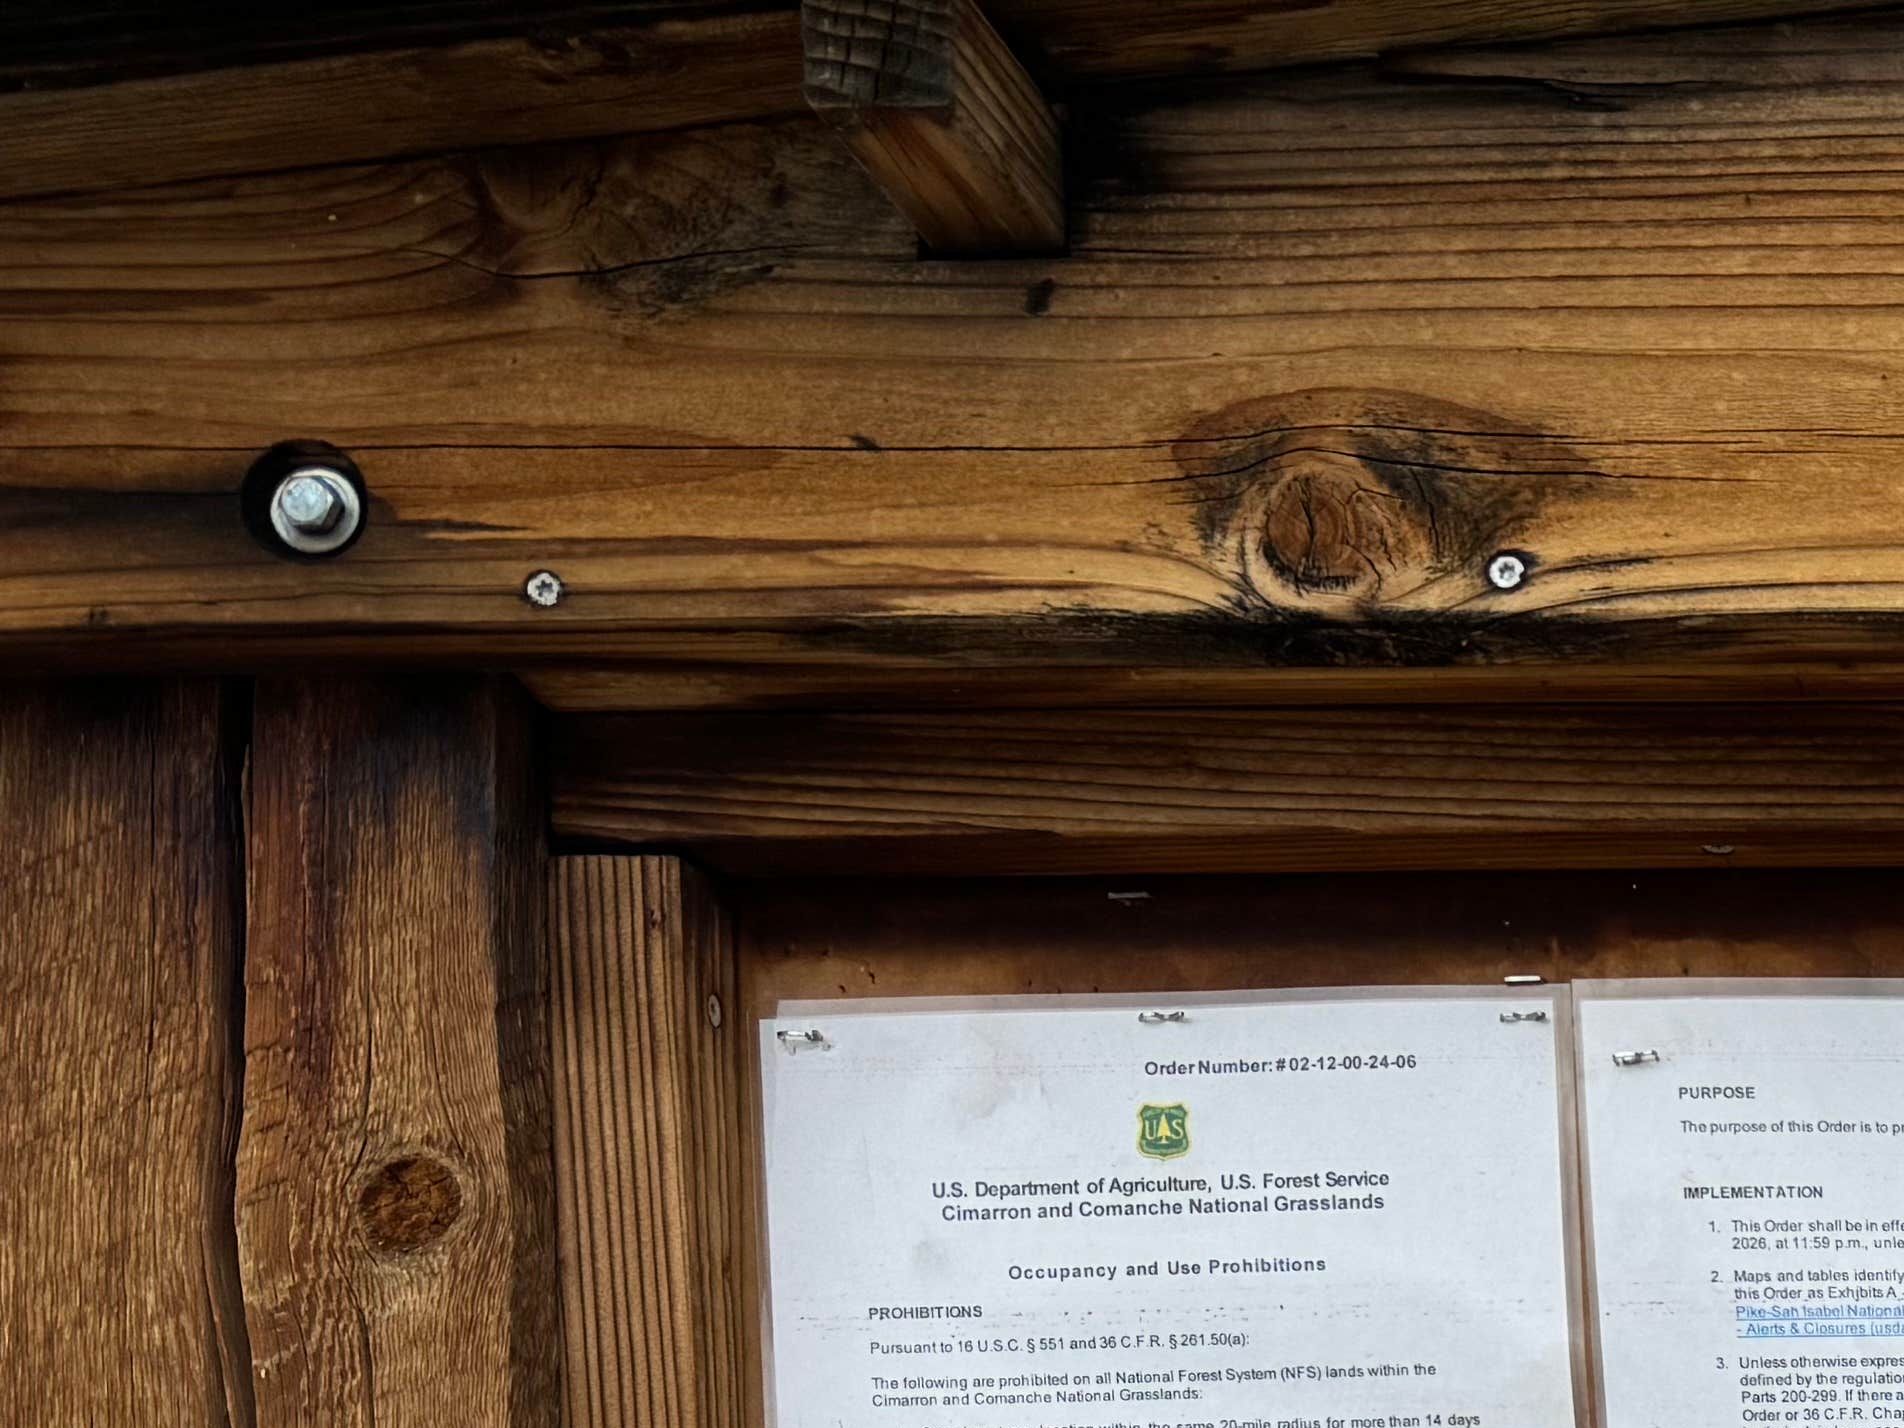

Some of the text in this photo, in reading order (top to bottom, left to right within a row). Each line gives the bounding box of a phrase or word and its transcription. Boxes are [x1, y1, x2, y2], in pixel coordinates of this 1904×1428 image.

[1145, 1060, 1196, 1076] Order
[1198, 1058, 1273, 1074] Number:
[1679, 1086, 1756, 1099] PURPOSE
[1681, 1119, 1708, 1132] The
[1710, 1122, 1768, 1135] purpose
[1771, 1119, 1785, 1132] of
[1788, 1119, 1814, 1132] this
[1817, 1119, 1857, 1132] Order
[1860, 1120, 1873, 1132] is
[1875, 1120, 1889, 1133] to
[932, 1169, 1390, 1200] U.S. Department of Agriculture, U.S. Forest Service
[1684, 1185, 1823, 1199] IMPLEMENTATION
[942, 1193, 1385, 1221] Cimarron and Comanche National Grasslands
[1009, 1257, 1326, 1282] Occupancy and Use Prohibitions
[869, 1305, 983, 1320] PROHIBITIONS
[871, 1340, 937, 1354] Pursuant
[940, 1341, 956, 1353] to
[959, 1339, 974, 1353] 16
[978, 1338, 1023, 1352] U.S.C.
[1040, 1337, 1064, 1350] 551
[1070, 1335, 1097, 1349] and
[1100, 1334, 1118, 1349] 36
[1121, 1333, 1165, 1348] C.F.R.
[1181, 1332, 1250, 1348] 261.50(a):
